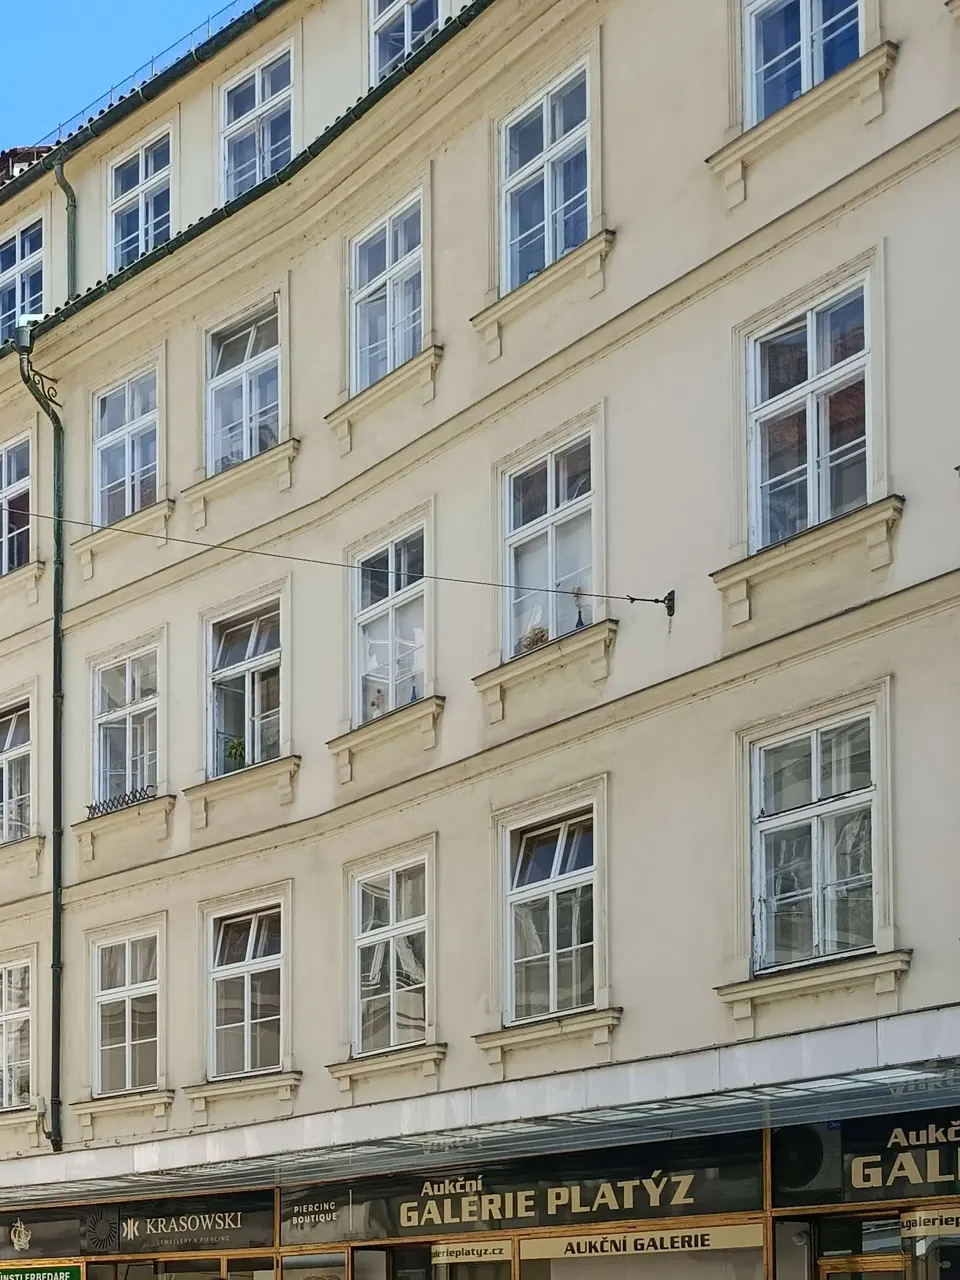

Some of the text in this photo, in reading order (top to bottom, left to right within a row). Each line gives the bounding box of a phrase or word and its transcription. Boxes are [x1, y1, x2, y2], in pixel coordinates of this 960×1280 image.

[851, 1147, 960, 1188] GAL
[421, 1174, 483, 1197] Aukční
[293, 1201, 336, 1213] PIERCING
[399, 1169, 695, 1227] GALERIE PLATÝZ
[146, 1211, 242, 1234] KRASOWSKI
[292, 1212, 338, 1225] BOUTIQUE
[157, 1238, 191, 1246] JEWELLERY
[200, 1235, 230, 1243] PIERCING
[564, 1233, 711, 1255] AUKČNÍ GALERIE
